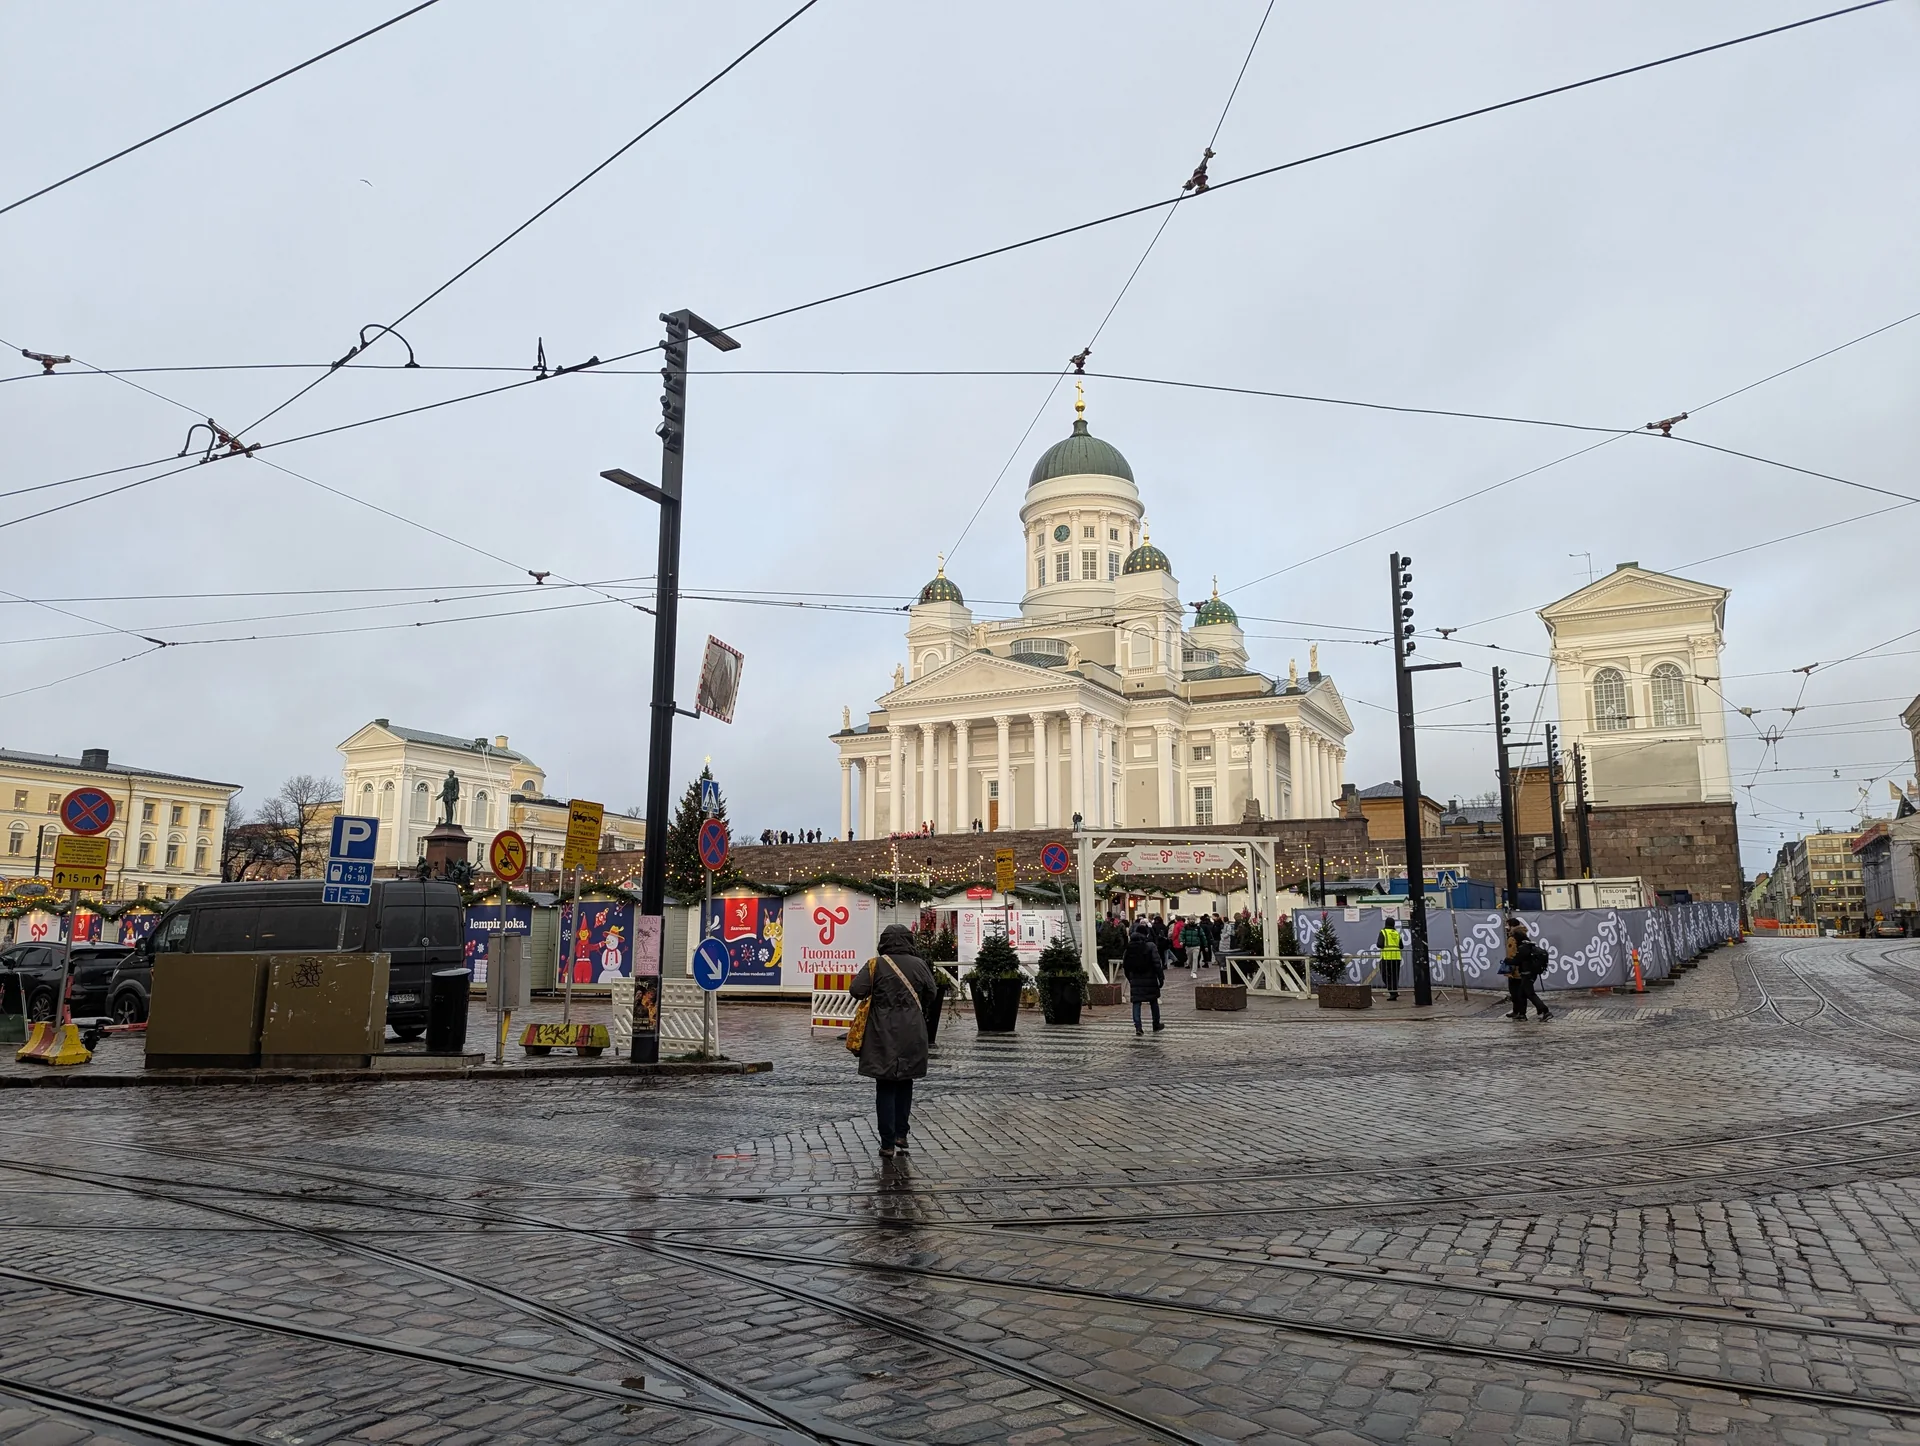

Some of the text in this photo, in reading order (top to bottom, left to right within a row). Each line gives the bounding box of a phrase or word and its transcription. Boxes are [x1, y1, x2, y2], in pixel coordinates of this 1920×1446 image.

[339, 819, 372, 856] P
[68, 873, 91, 883] 15 m
[800, 946, 856, 960] Tuomaan
